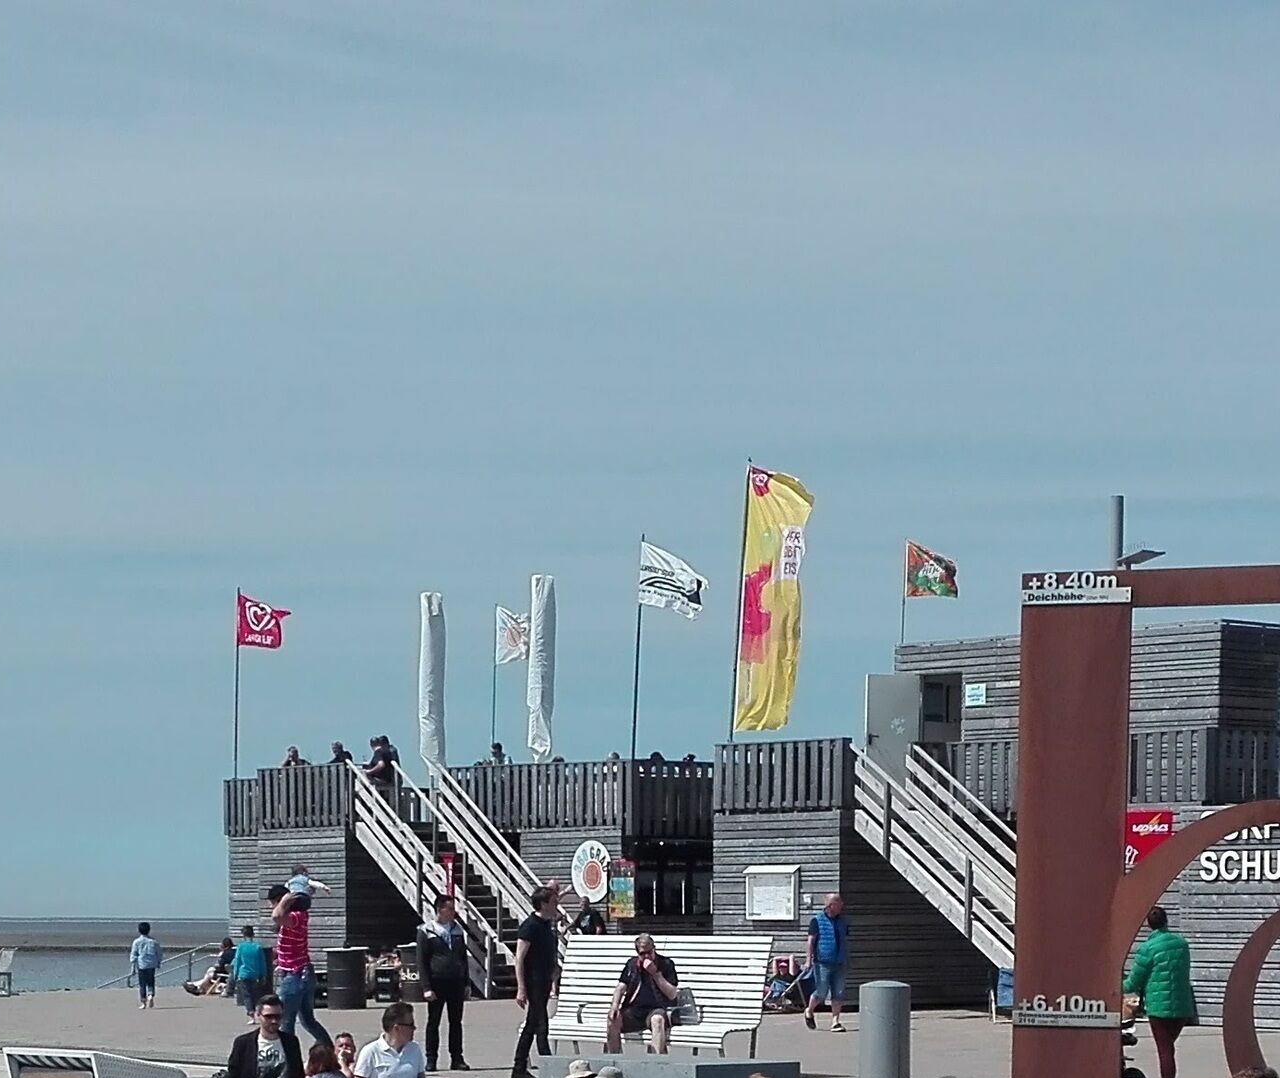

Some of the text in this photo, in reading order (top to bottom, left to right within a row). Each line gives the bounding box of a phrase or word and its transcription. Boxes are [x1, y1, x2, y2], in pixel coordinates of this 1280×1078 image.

[1028, 571, 1118, 590] +8.40m
[1027, 592, 1084, 602] Deichhöhe
[1019, 994, 1106, 1013] +6.10m
